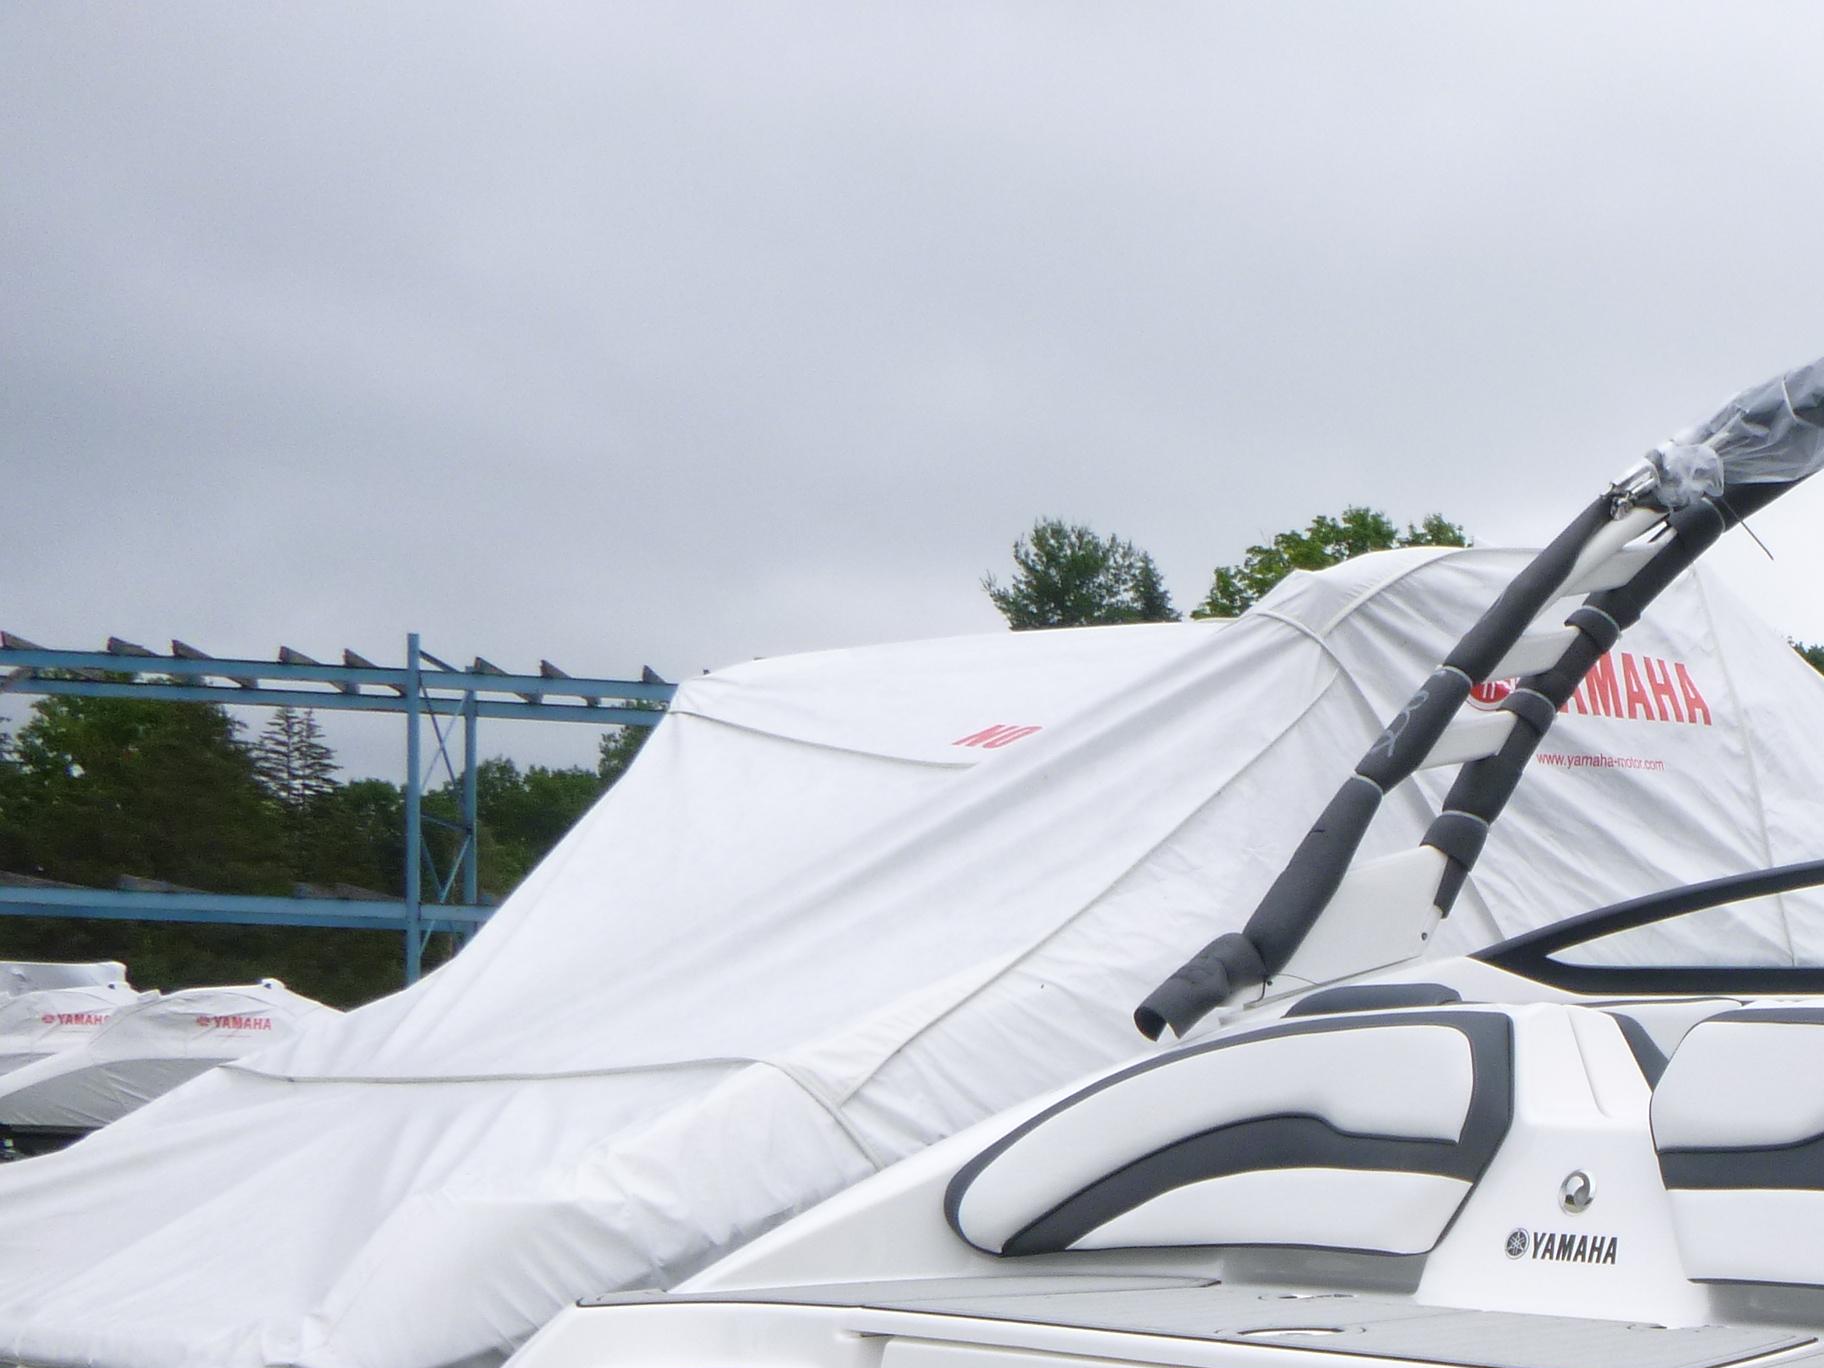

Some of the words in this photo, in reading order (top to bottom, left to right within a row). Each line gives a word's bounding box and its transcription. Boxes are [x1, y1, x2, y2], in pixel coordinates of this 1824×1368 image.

[1536, 753, 1665, 771] www.yamaha-motor.com
[212, 1015, 272, 1031] YAMAHA
[1531, 1231, 1619, 1265] YAMAHA
